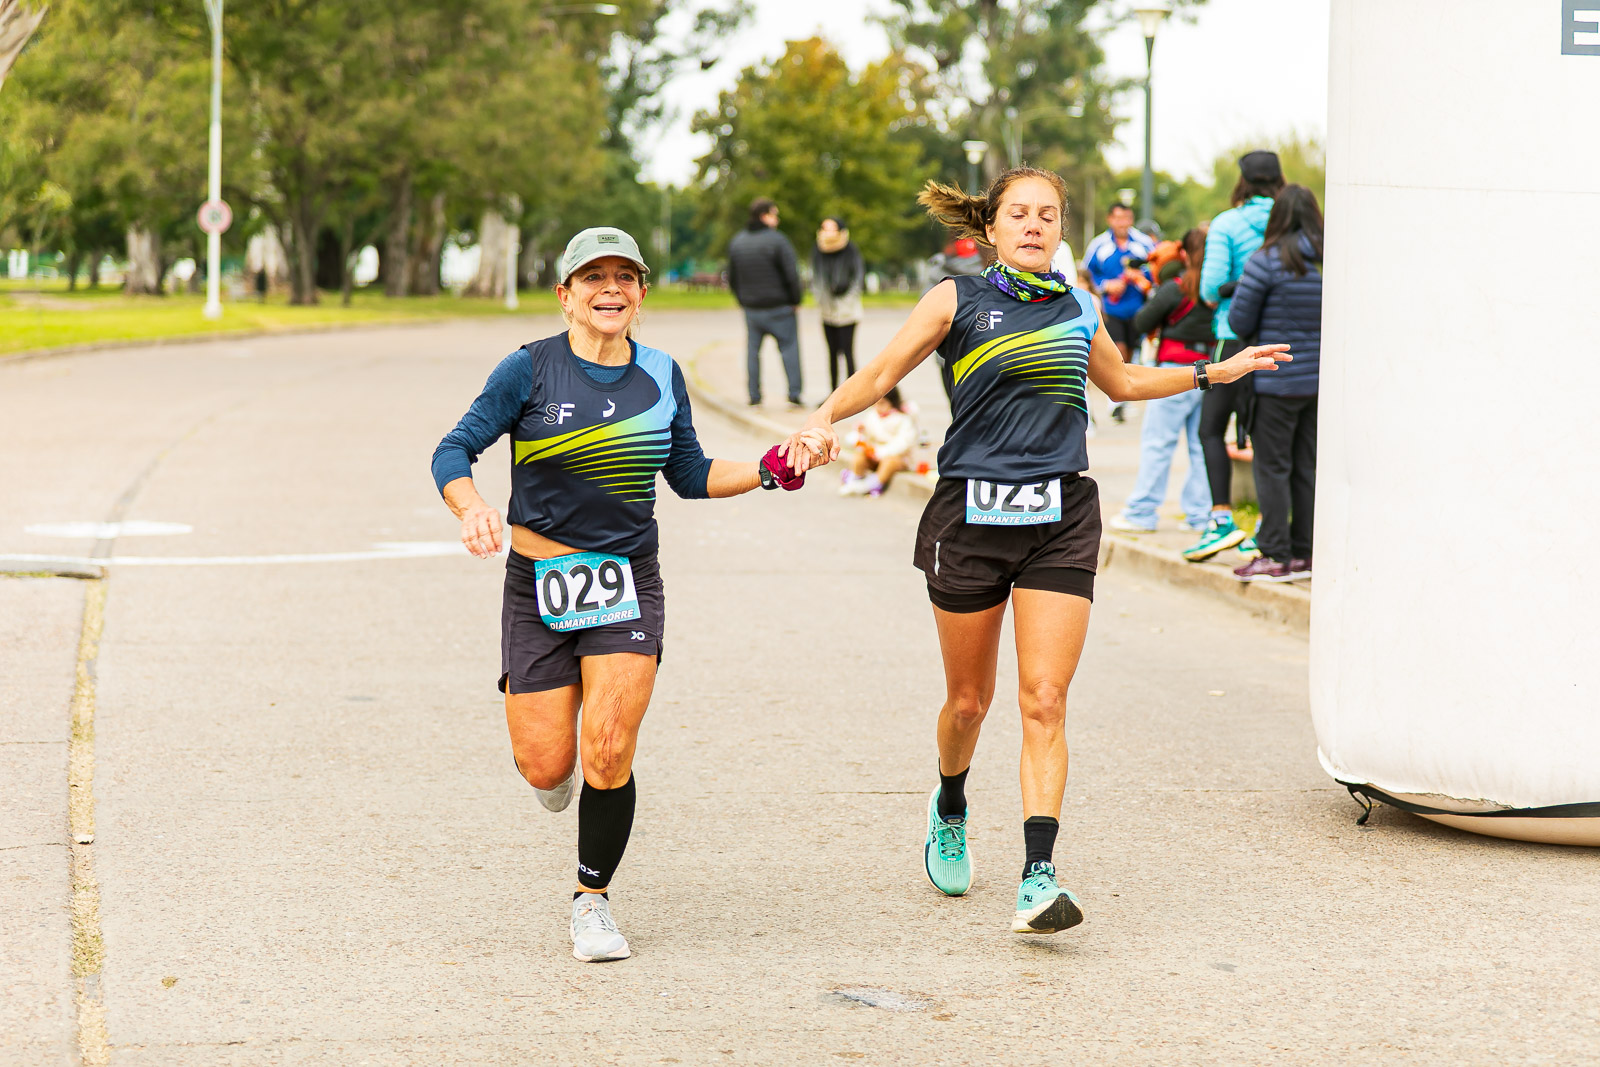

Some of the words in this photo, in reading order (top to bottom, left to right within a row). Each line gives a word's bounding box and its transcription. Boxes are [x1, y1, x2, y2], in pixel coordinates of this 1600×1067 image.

[975, 310, 1004, 332] SF
[543, 402, 576, 425] SF
[970, 514, 1021, 524] DIAMANTE
[1022, 514, 1056, 524] CORRE
[542, 559, 625, 617] 029
[549, 615, 600, 630] DIAMANTE
[600, 608, 635, 623] CORRE
